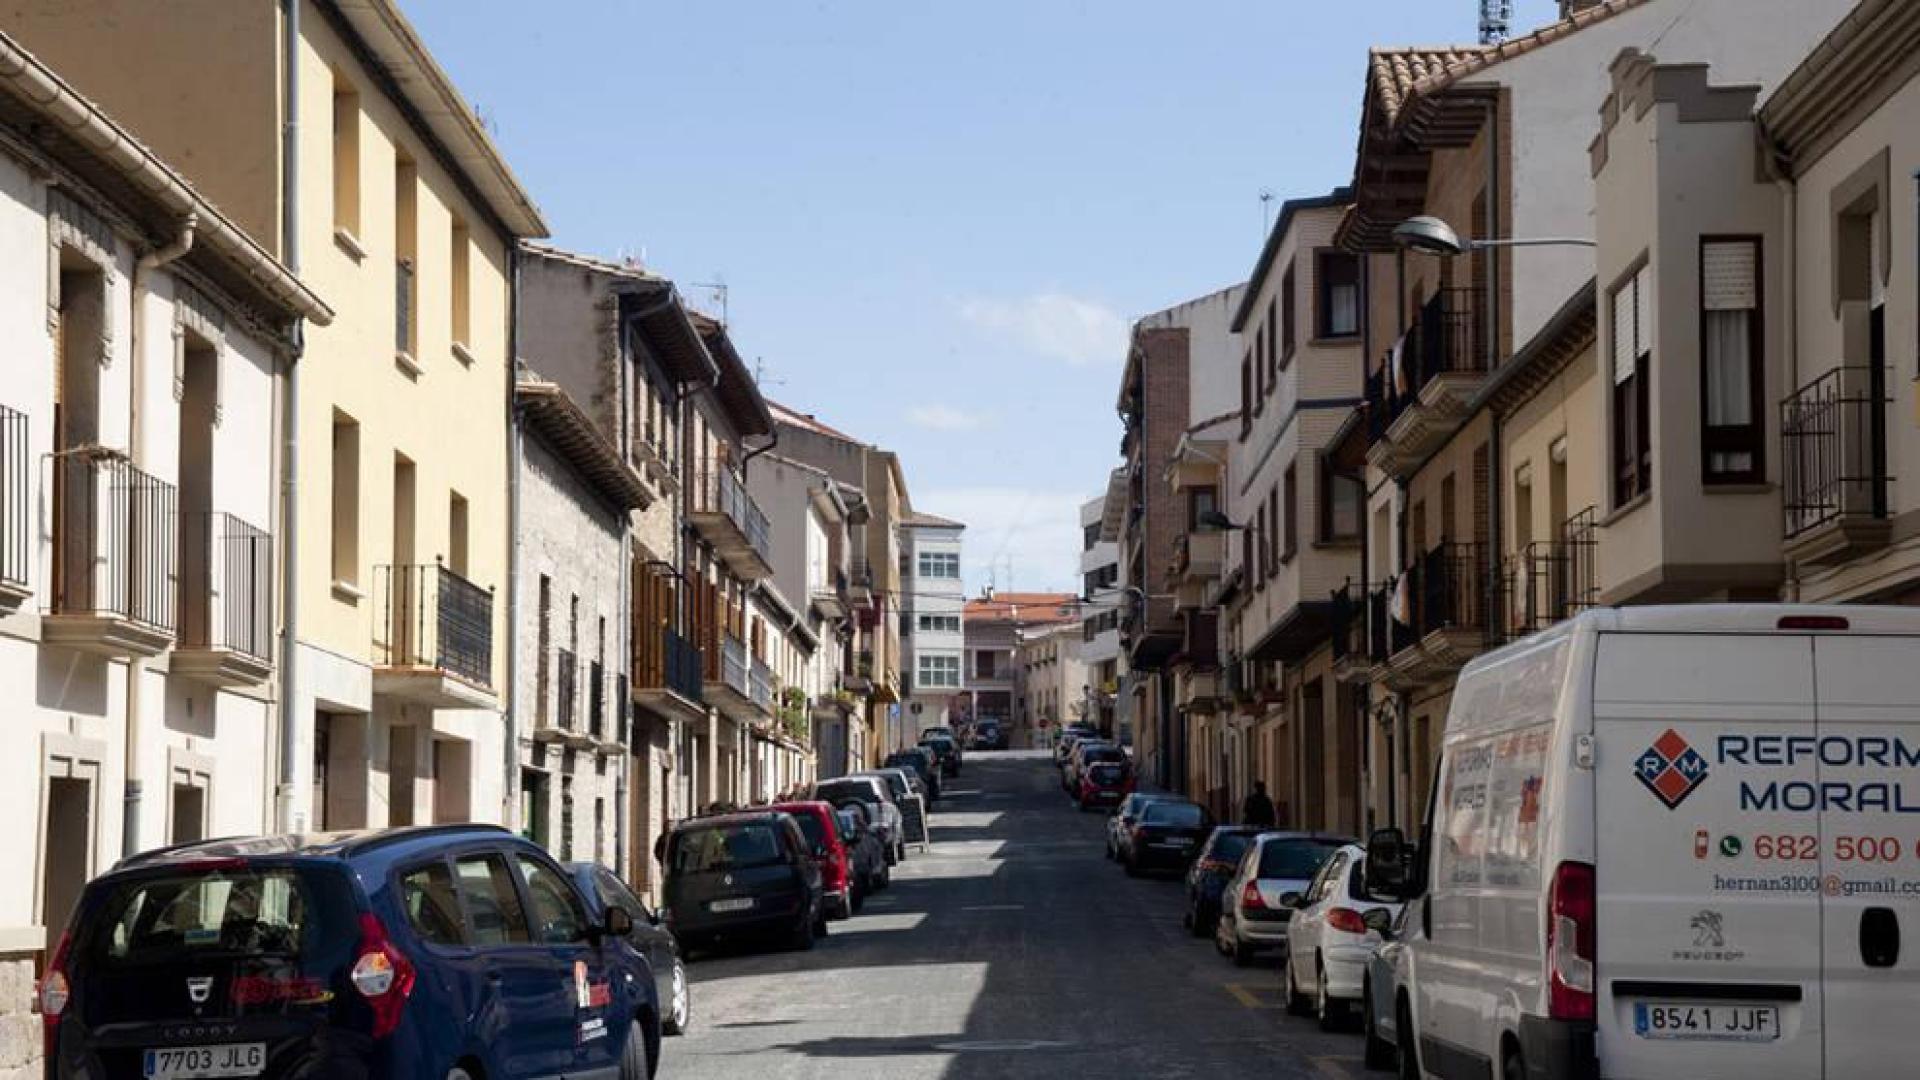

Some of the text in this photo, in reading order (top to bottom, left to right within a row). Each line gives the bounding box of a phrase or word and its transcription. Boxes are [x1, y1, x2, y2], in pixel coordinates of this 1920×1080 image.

[1718, 736, 1920, 767] REFORM
[1740, 781, 1920, 813] MORAL
[1754, 835, 1818, 860] 682
[1834, 836, 1901, 862] 500
[1651, 1007, 1770, 1031] 8541 JJF
[160, 1046, 261, 1072] 7703 JLG
